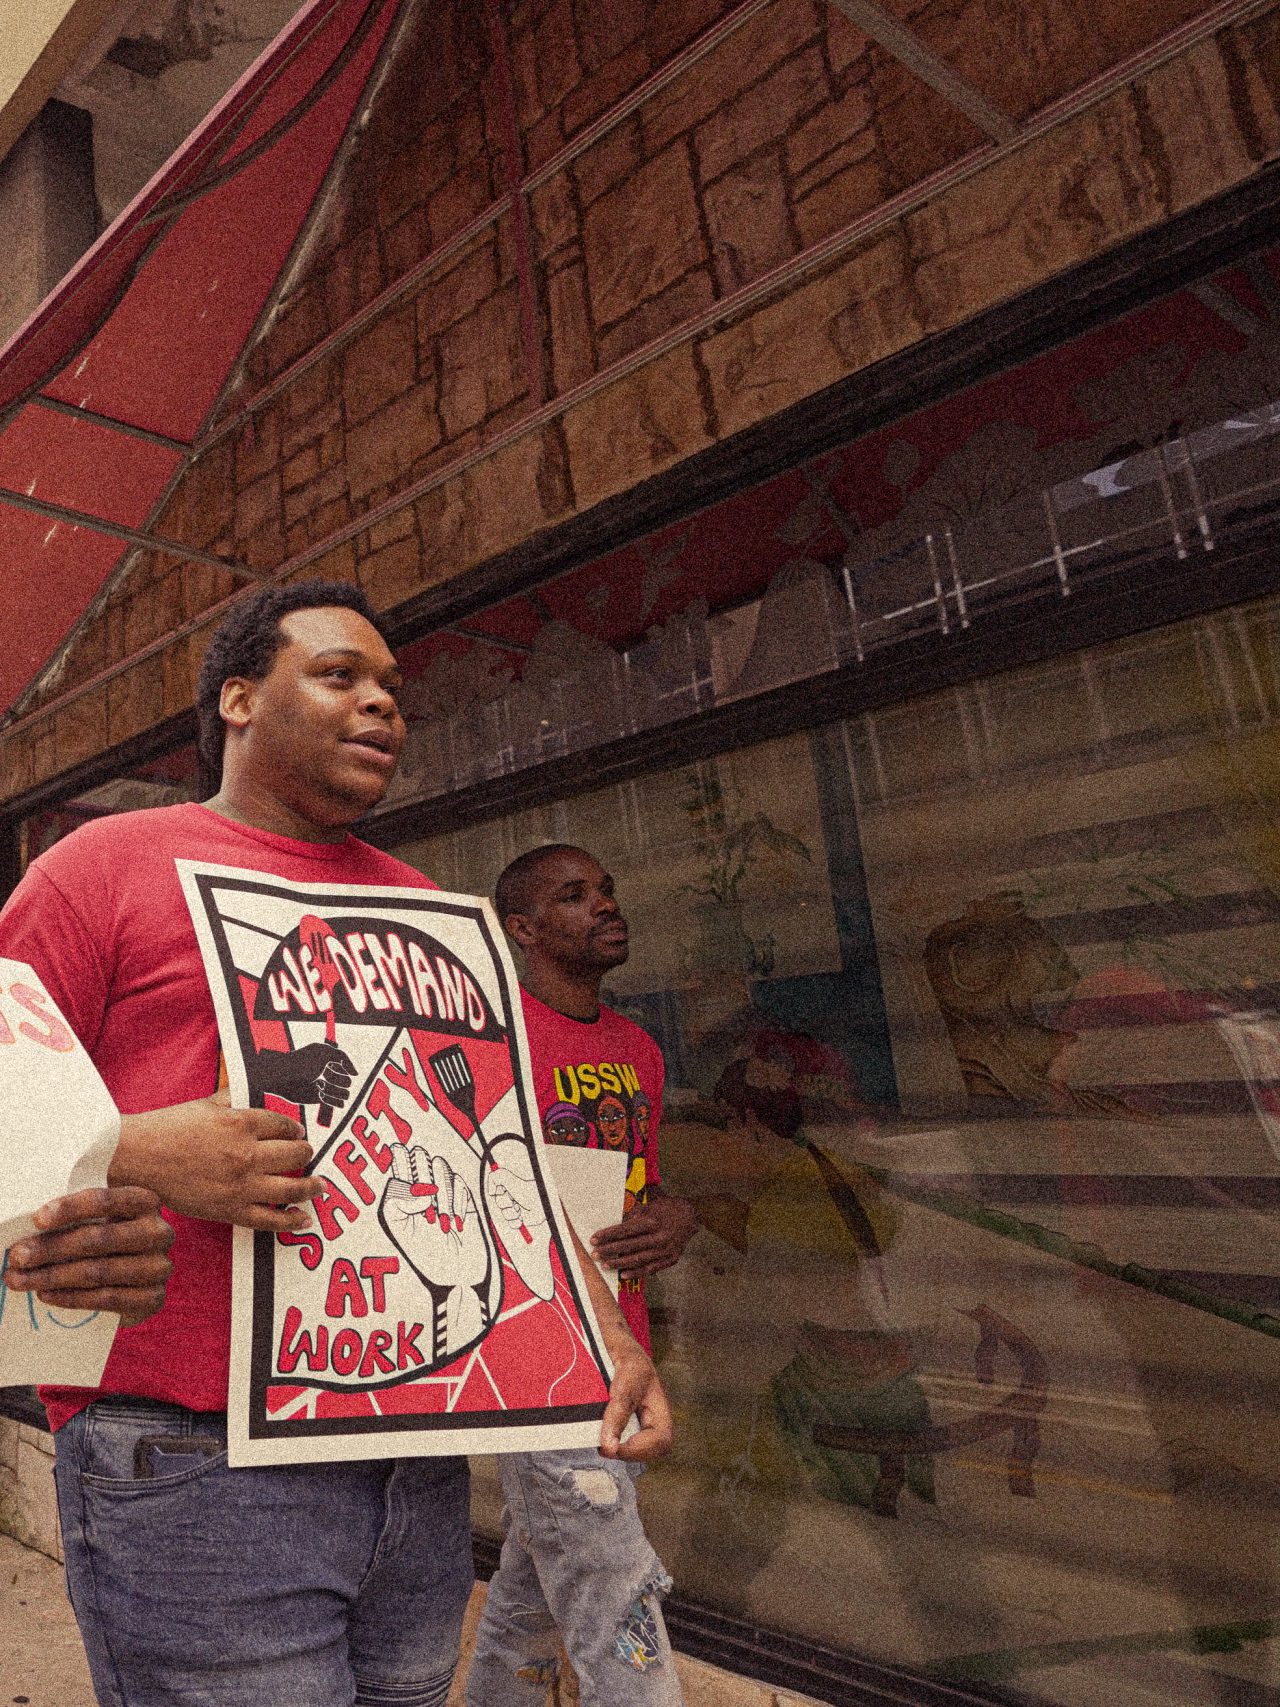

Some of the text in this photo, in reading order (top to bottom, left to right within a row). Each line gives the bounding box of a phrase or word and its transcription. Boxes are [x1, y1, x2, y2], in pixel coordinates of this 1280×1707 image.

[267, 932, 486, 1031] WE DEMAND
[552, 1062, 641, 1106] USSW
[277, 1047, 431, 1269] SAFETY
[325, 1256, 400, 1319] AT
[276, 1305, 426, 1378] WORK
